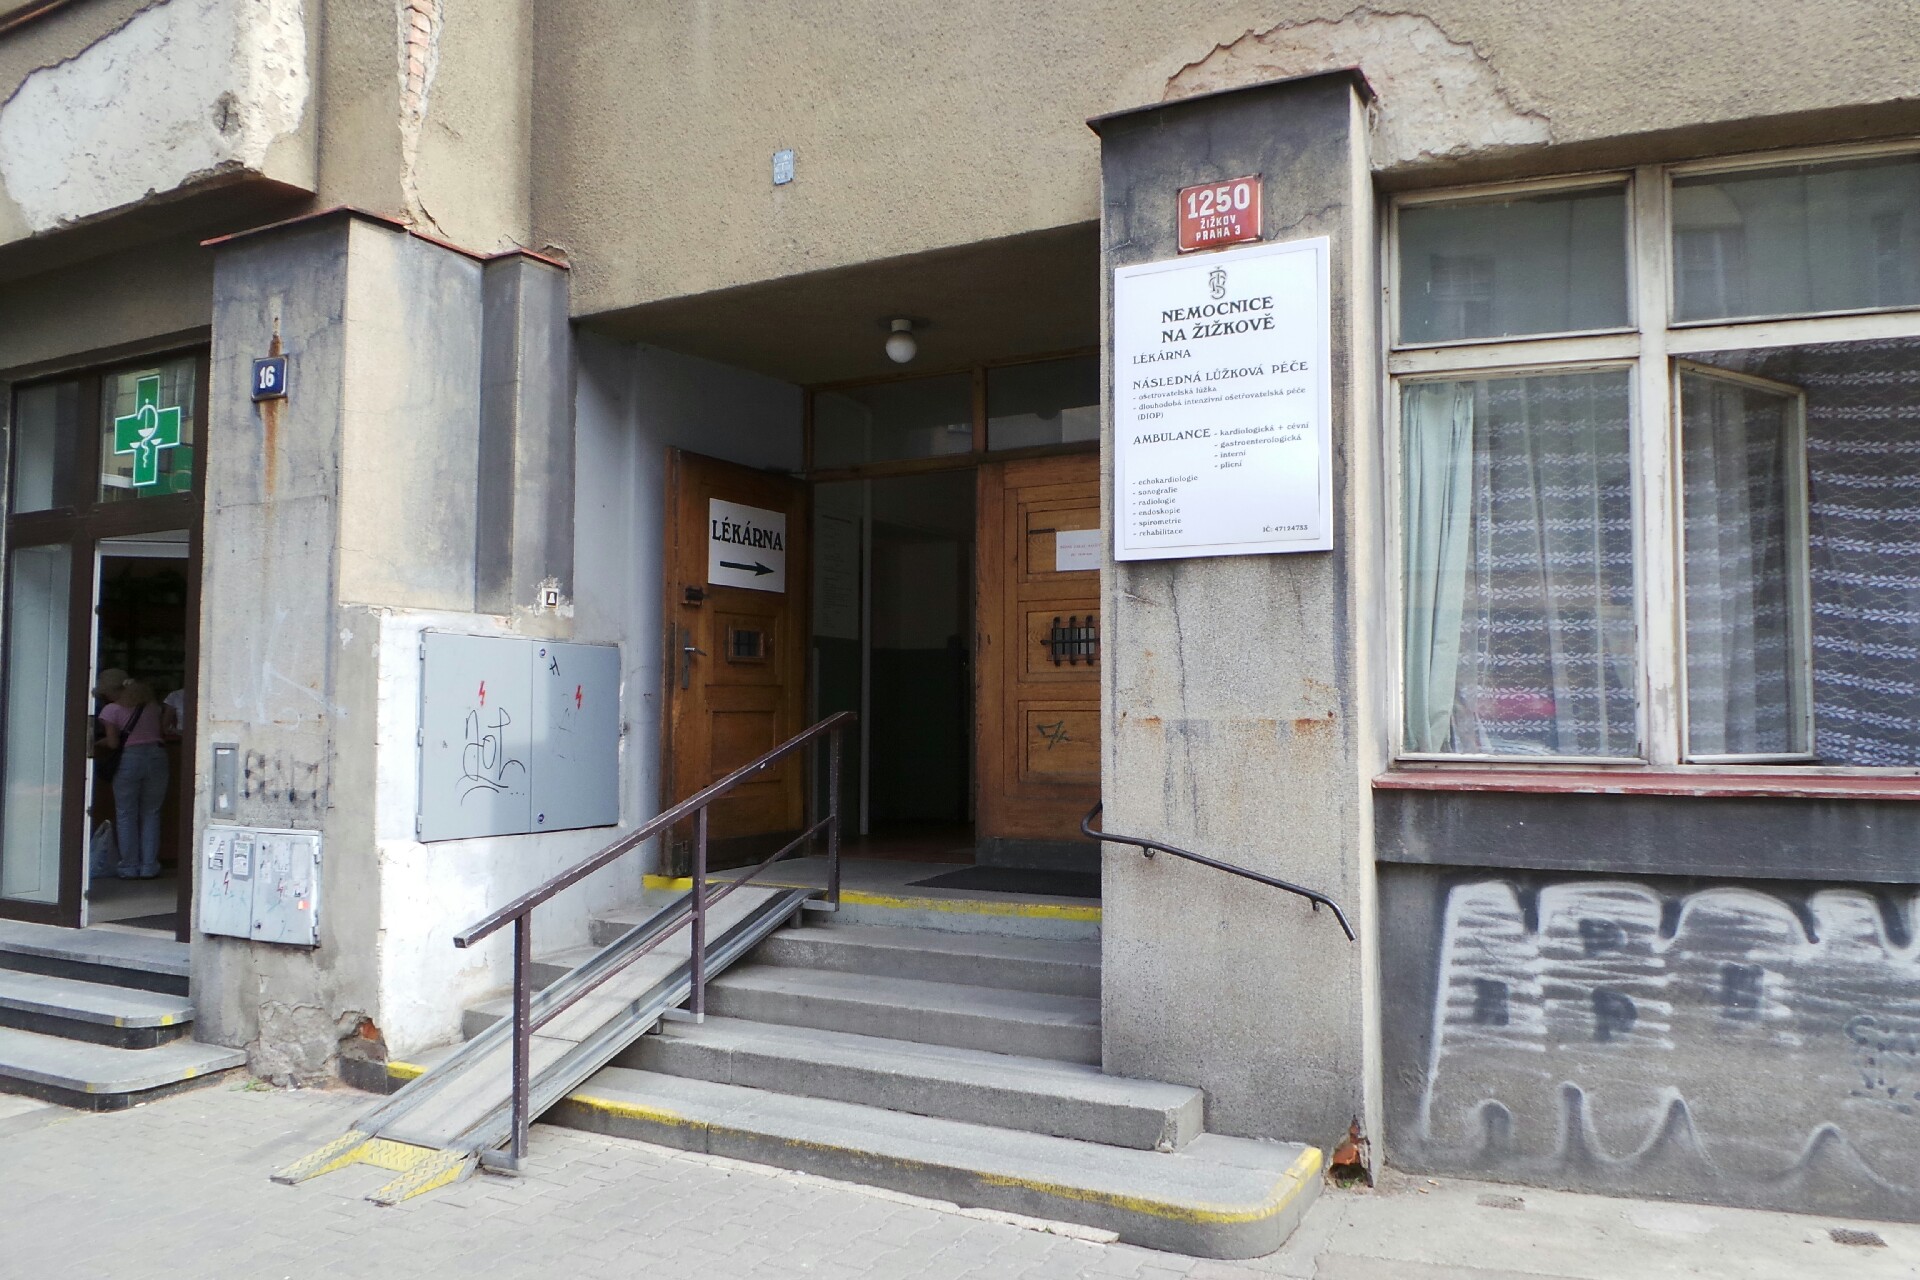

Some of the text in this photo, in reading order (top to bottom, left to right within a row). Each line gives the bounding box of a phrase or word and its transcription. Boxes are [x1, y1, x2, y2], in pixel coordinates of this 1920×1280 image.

[1187, 183, 1250, 219] 1250
[1200, 214, 1236, 229] ŽIŽKOV
[1196, 224, 1241, 242] PRAHA 3
[1161, 296, 1274, 323] NEMOCNICE
[1161, 313, 1276, 343] NA ŽIŽKOVĚ
[1133, 349, 1192, 364] LÉKÁRNA
[260, 365, 276, 389] 16
[1132, 359, 1309, 390] NÁSLEDNÁ LŮŽKOVÁ PÉČE
[1138, 399, 1183, 411] dlouhodobá
[1224, 388, 1284, 401] ošetřovatelská
[1286, 386, 1307, 396] péče
[1137, 411, 1164, 421] (DIOP)
[1132, 428, 1211, 445] AMBULANCE
[1219, 424, 1275, 437] kardiologická
[1286, 421, 1310, 430] cévní
[1220, 433, 1302, 449] gastroenterologická
[1220, 449, 1246, 458] interní
[1220, 459, 1243, 470] plicní
[1138, 474, 1199, 486] echokardiologie
[1138, 486, 1178, 496] sonografie
[1138, 497, 1176, 506] radiologie
[1138, 507, 1181, 516] endoskopie
[1138, 517, 1183, 528] spirometrie
[712, 516, 784, 551] LÉKÁRNA
[1138, 528, 1184, 537] rehabilitace
